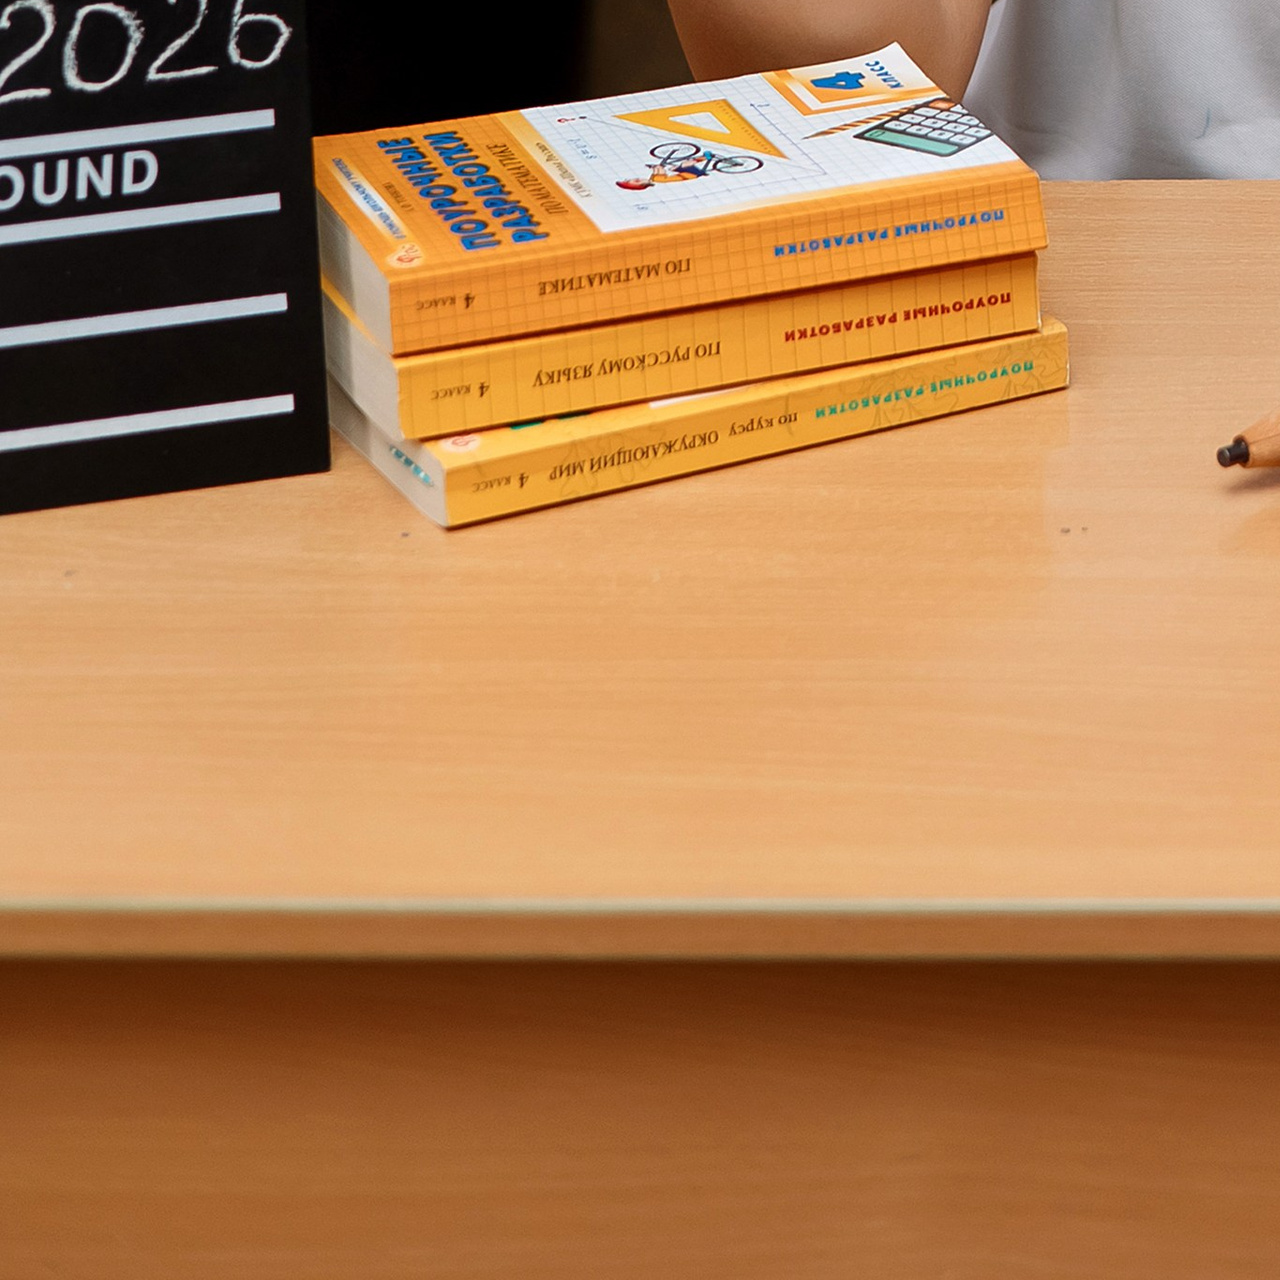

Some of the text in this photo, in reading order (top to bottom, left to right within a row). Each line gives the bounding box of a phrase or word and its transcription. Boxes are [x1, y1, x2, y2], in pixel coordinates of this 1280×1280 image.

[810, 71, 866, 90] 4
[865, 60, 904, 89] КЛАСС
[485, 143, 555, 200] МАТЕМАТИКЕ
[377, 137, 502, 252] ПОУРОЧНЫЕ
[423, 130, 550, 243] РАЗРАБОТКИ
[895, 209, 1004, 238] ПОУРОЧНЫЕ
[774, 227, 888, 257] РАЗРАБОТКИ
[538, 263, 661, 296] МАТЕМАТИКЕ
[665, 258, 691, 275] ПО
[464, 292, 475, 309] 4
[903, 292, 1011, 321] ПОУРОЧНЫЕ
[785, 312, 897, 342] РАЗРАБОТКИ
[597, 345, 690, 377] РУССКОМУ
[696, 341, 721, 357] ПО
[479, 382, 490, 398] 4
[532, 364, 593, 387] ЯЗЫКУ
[930, 360, 1034, 394] ПОУРОЧНЫЕ
[815, 385, 924, 419] РАЗРАБОТКИ
[728, 417, 774, 437] курсу
[778, 412, 798, 426] по
[589, 430, 719, 471] ОКРУЖАЮЩИЙ
[517, 472, 530, 488] 4
[549, 459, 586, 481] МИР
